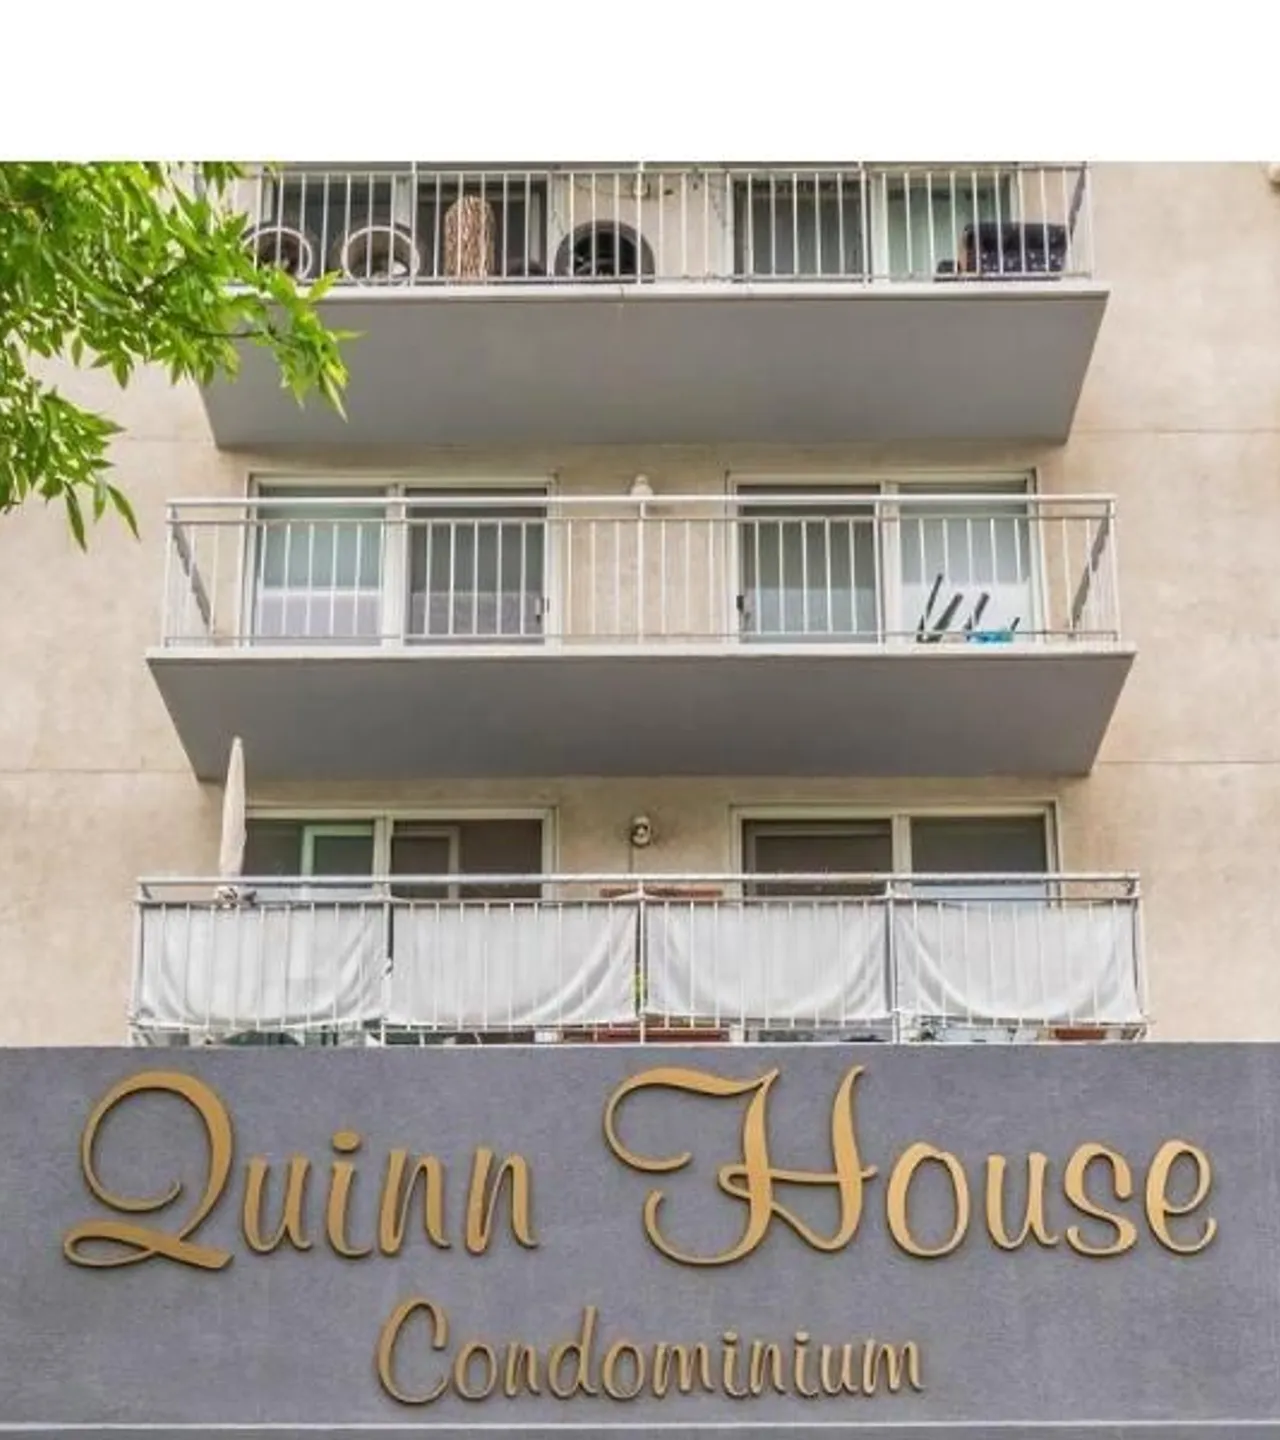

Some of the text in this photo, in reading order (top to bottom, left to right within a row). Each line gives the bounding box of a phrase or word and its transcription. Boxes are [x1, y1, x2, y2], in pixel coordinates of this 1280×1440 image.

[62, 1064, 1218, 1269] Quinn House
[374, 1296, 924, 1402] Condominium
